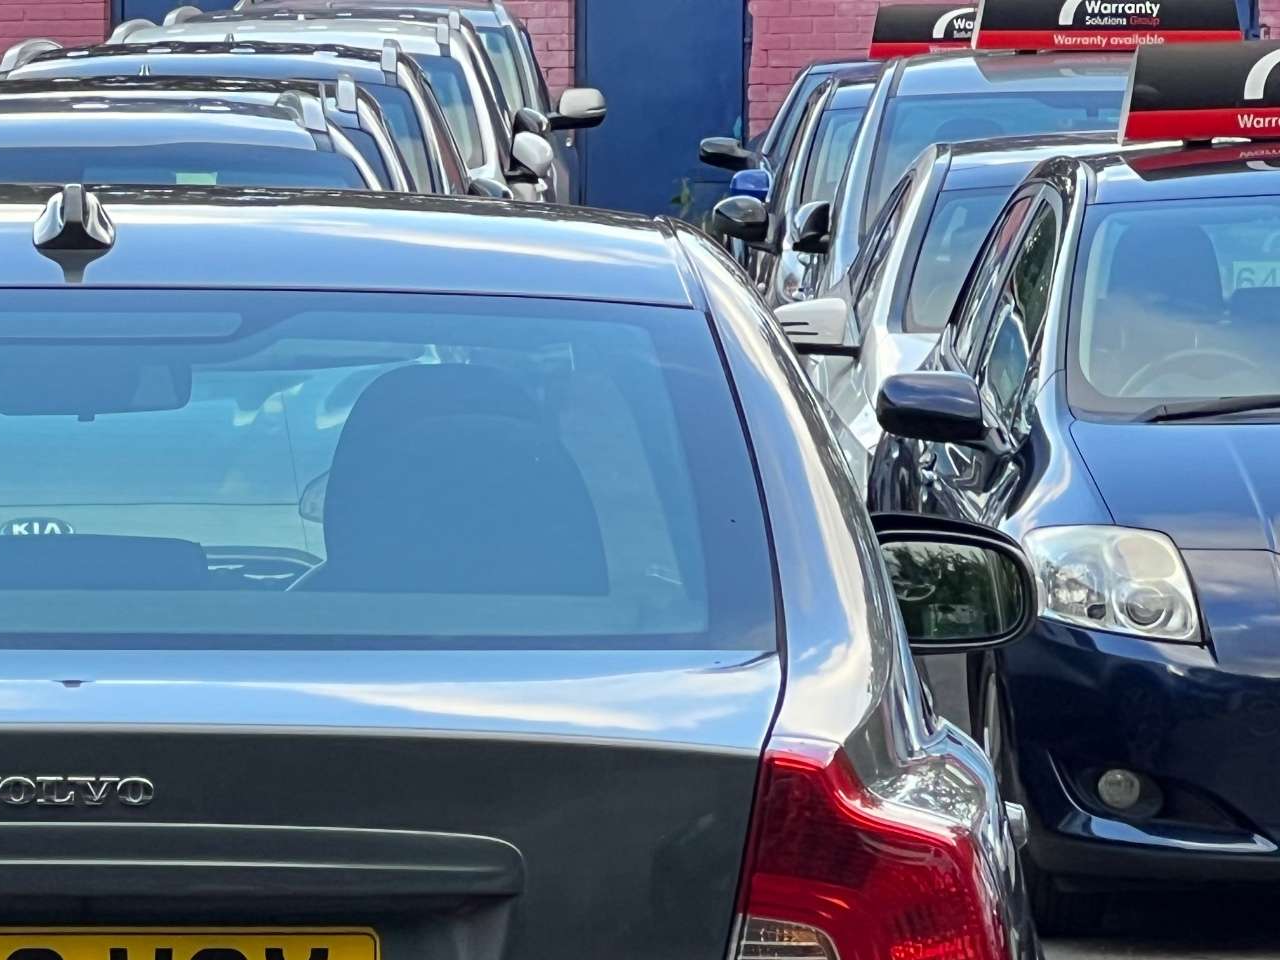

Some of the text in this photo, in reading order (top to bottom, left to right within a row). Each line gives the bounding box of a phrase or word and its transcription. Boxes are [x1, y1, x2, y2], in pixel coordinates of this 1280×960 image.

[1085, 0, 1160, 17] Warranty
[953, 18, 974, 30] Wa
[1085, 16, 1127, 25] Solutions
[1053, 33, 1165, 47] Warranty available
[1237, 113, 1280, 128] Warr
[12, 522, 62, 536] KIA
